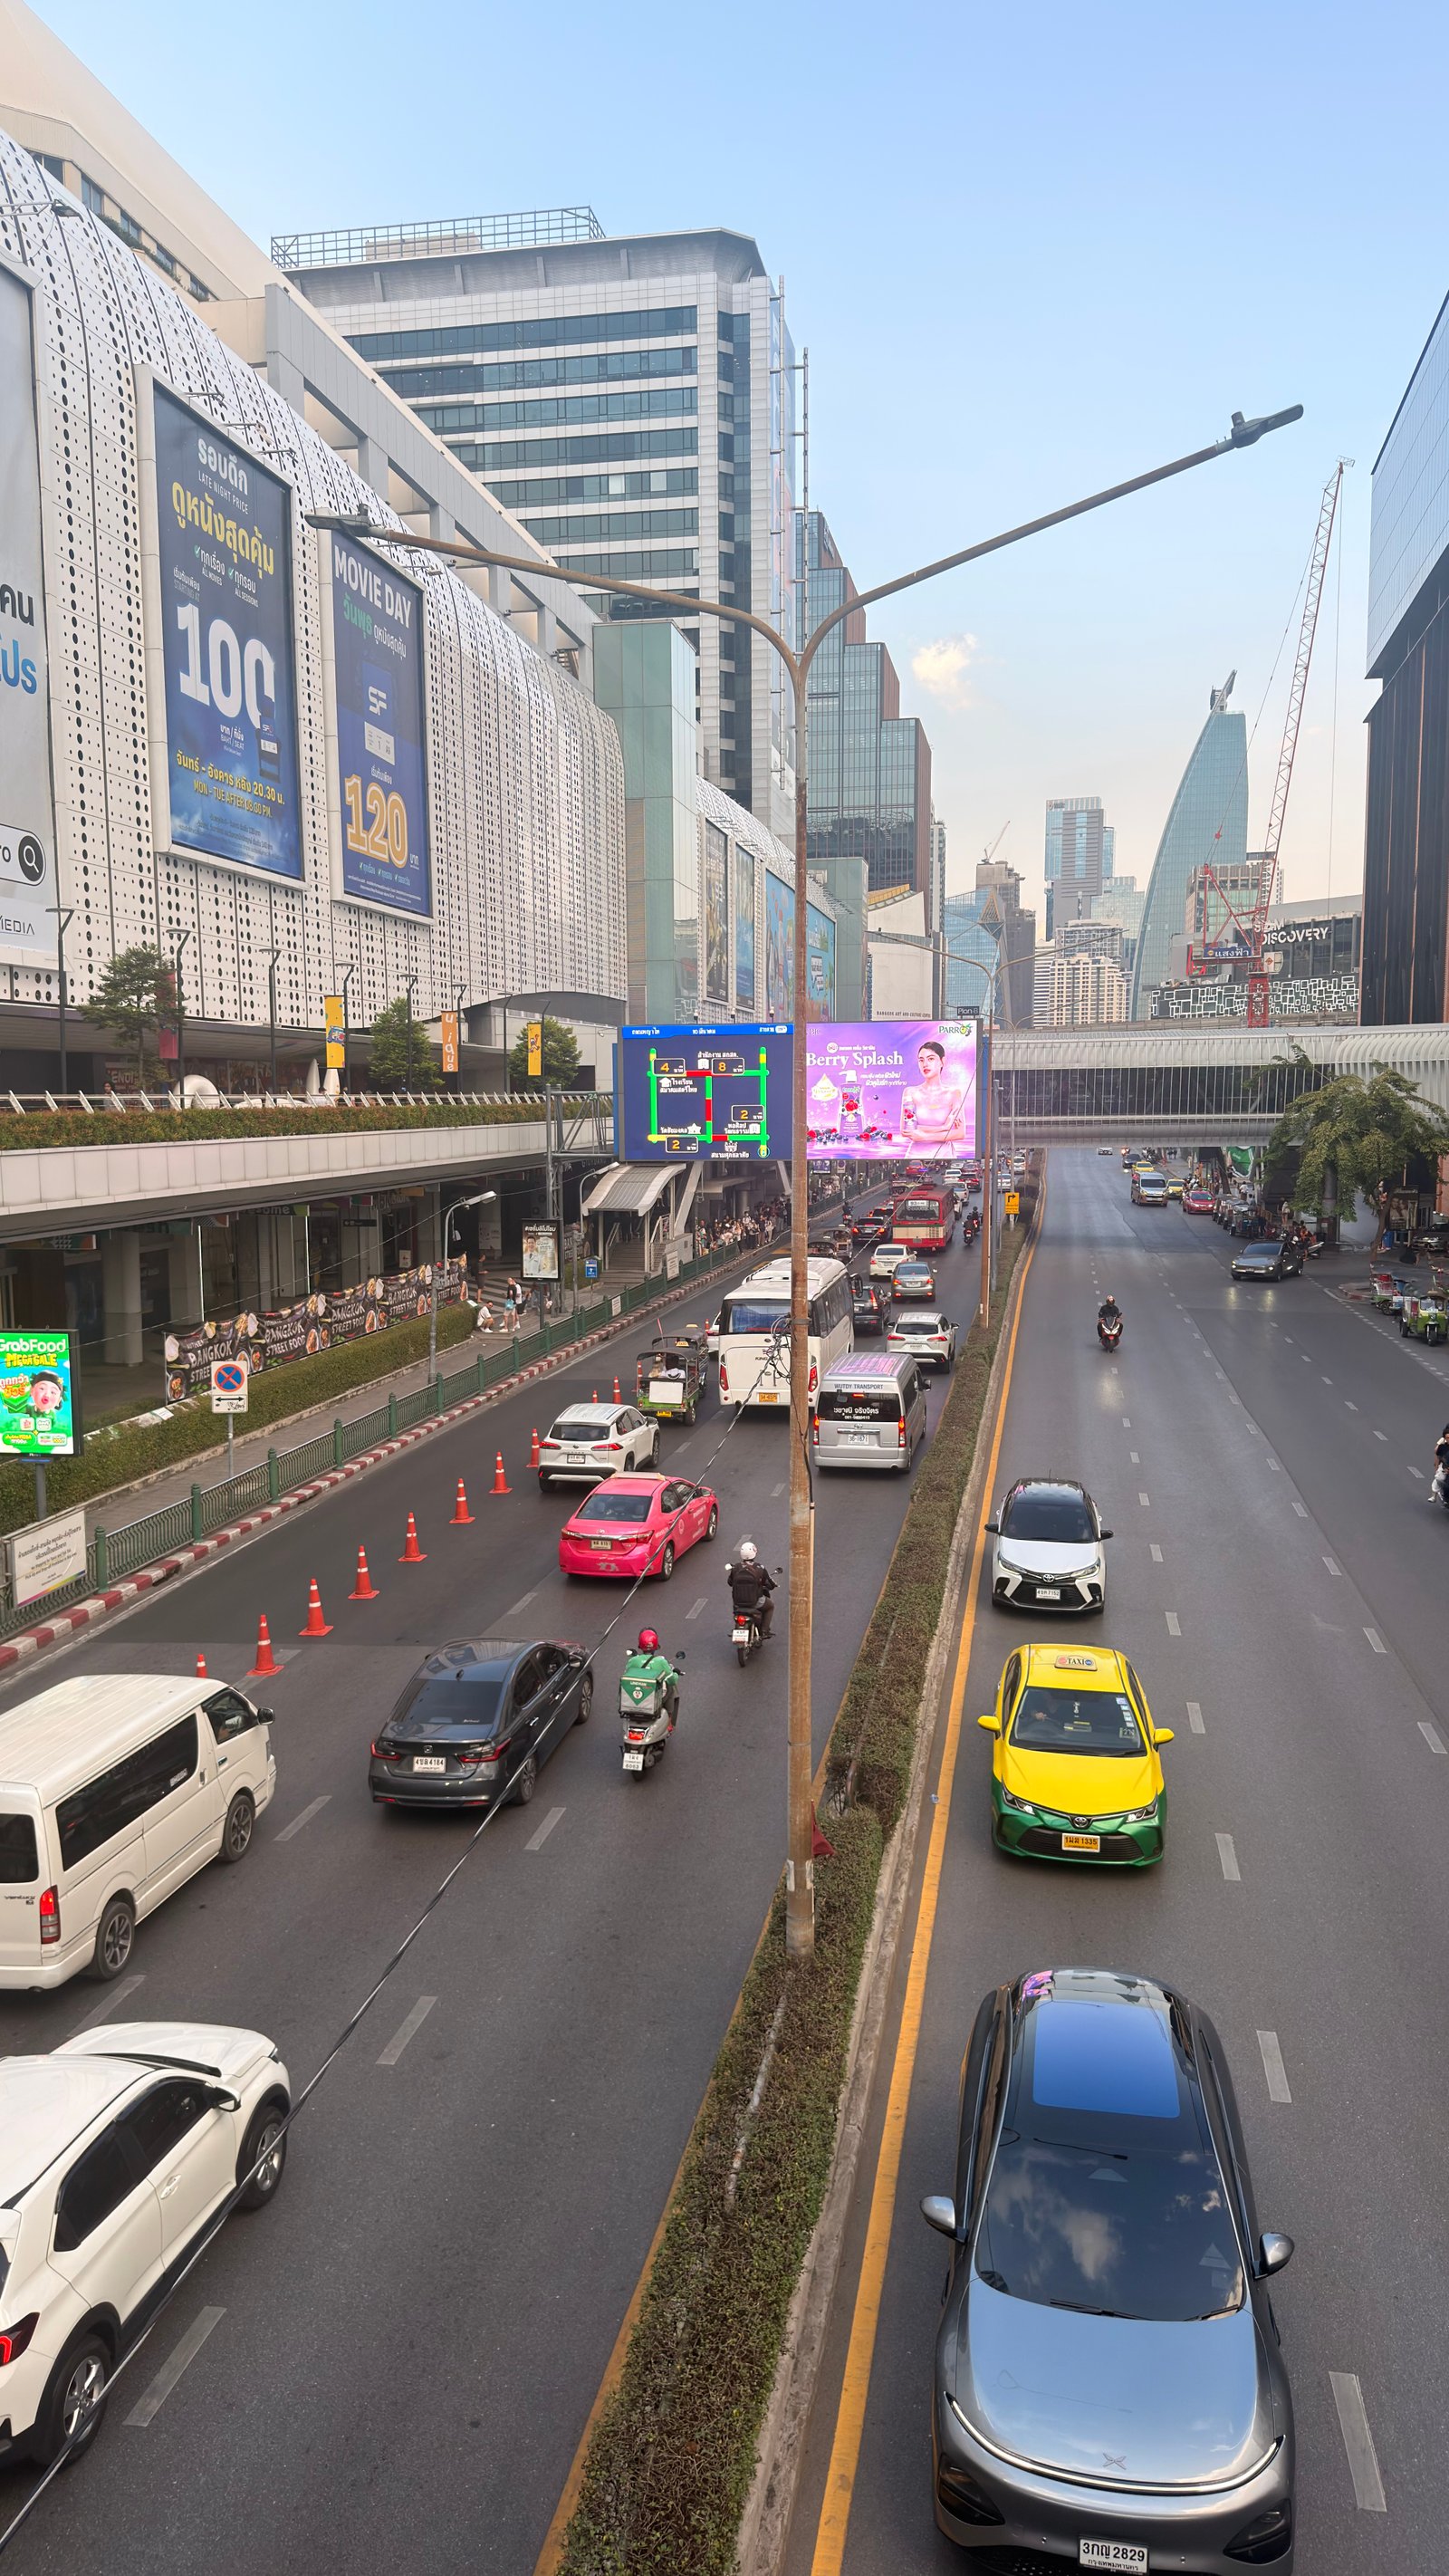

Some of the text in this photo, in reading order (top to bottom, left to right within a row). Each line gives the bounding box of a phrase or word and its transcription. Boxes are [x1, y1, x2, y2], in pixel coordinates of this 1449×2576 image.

[197, 438, 248, 495] รอบดึก
[198, 470, 249, 515] LATE NIGHT PRICE
[172, 482, 274, 580] ดูหนังสุดคุ้ม
[334, 545, 412, 629] MOVIE DAY
[177, 602, 275, 728] 100
[368, 686, 387, 716] SF
[194, 780, 208, 795] MON
[213, 786, 226, 802] TUE
[226, 792, 245, 809] AFTER
[254, 782, 275, 802] 20.30
[344, 774, 408, 869] 120
[1262, 927, 1329, 946] DISCOVERY
[1214, 947, 1250, 957] แสงฟ้า
[445, 1013, 455, 1072] uique
[659, 1062, 670, 1072] 4
[718, 1062, 726, 1072] 8
[806, 1051, 904, 1069] Berry Splash
[740, 1110, 749, 1120] 2
[671, 1139, 680, 1149] 2
[388, 1287, 417, 1305] BANGKOK
[331, 1302, 366, 1321] BANGKOK
[389, 1300, 417, 1316] STREET FOOD
[264, 1320, 305, 1343] BANGKOK
[331, 1316, 365, 1334] STREET FOOD
[187, 1340, 233, 1368] BANGKOK
[265, 1335, 306, 1357] STREET FOOD
[5, 1353, 33, 1368] MEGA
[190, 1370, 212, 1383] STREE
[1082, 2542, 1145, 2562] 3กญ 2829
[1088, 2559, 1138, 2571] กรุงเทพมหานคร
